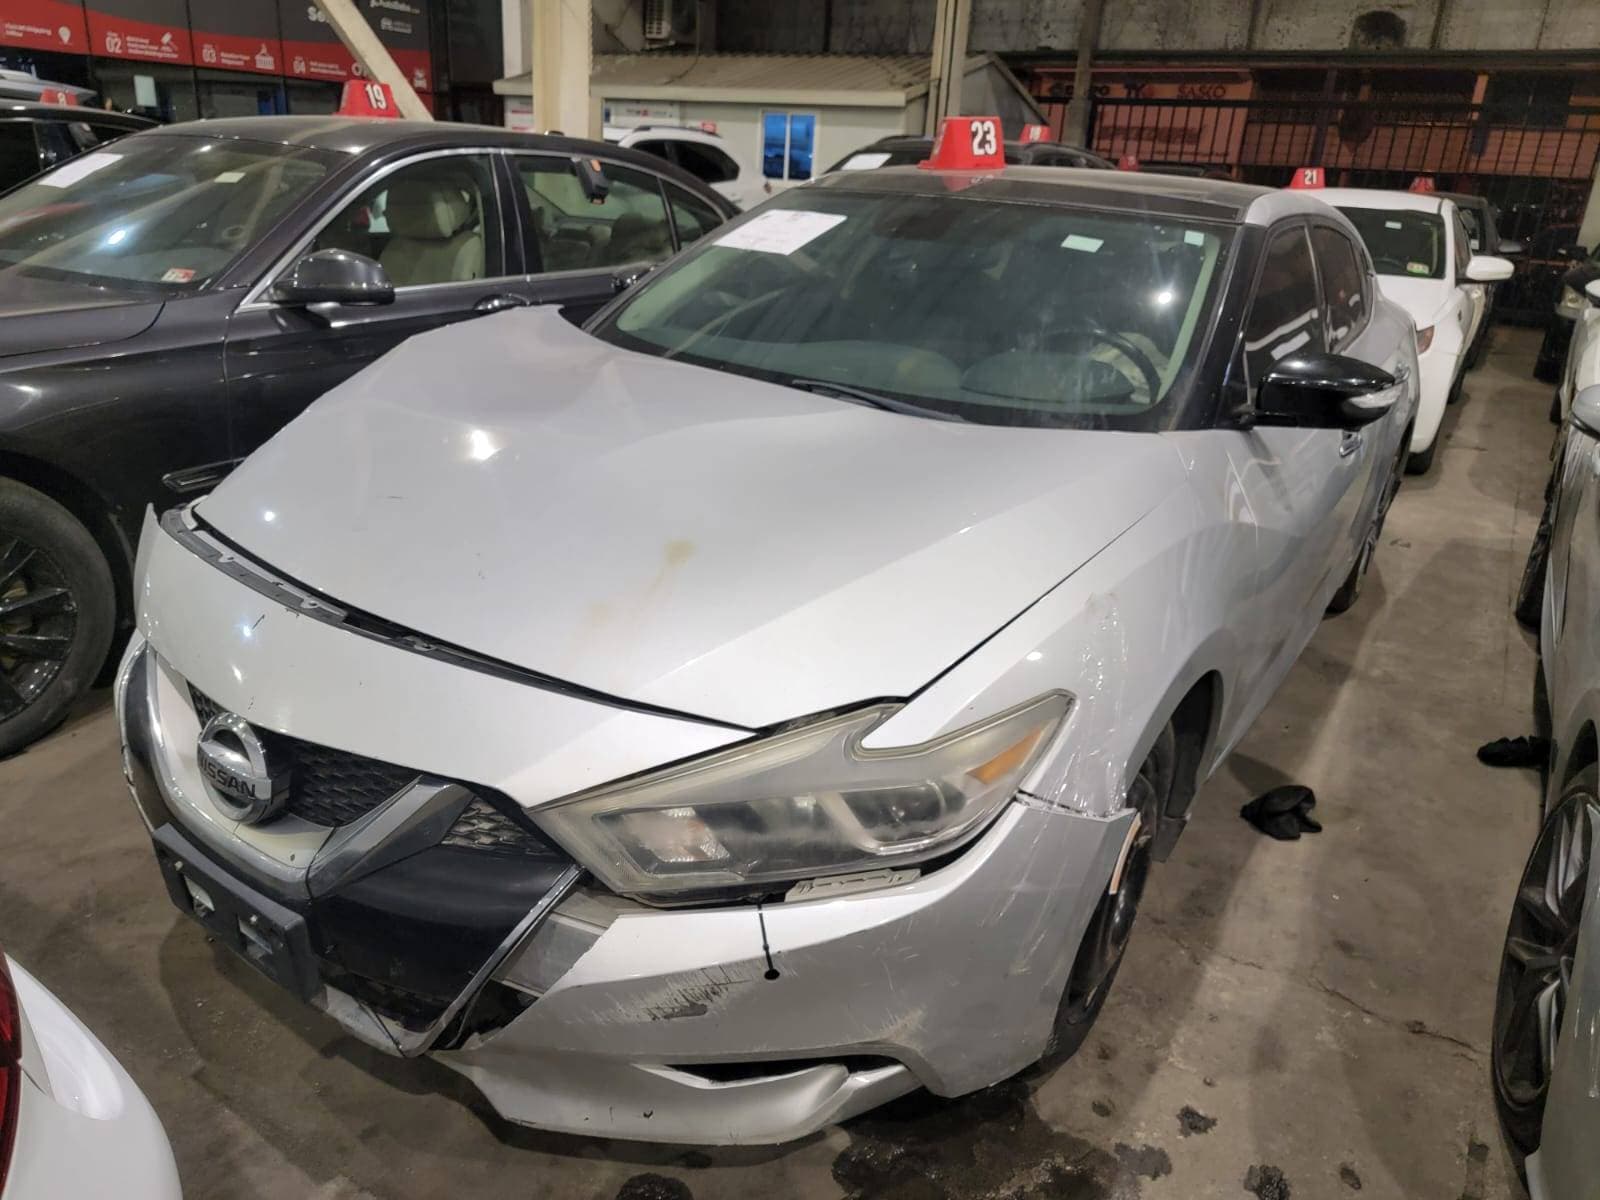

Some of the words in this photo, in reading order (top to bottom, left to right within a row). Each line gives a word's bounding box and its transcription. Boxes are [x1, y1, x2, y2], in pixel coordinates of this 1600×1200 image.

[105, 36, 122, 53] 02
[202, 47, 216, 63] 03
[365, 83, 387, 109] 19
[971, 120, 997, 155] 23
[1303, 169, 1318, 185] 21
[200, 757, 255, 799] NISSAN
